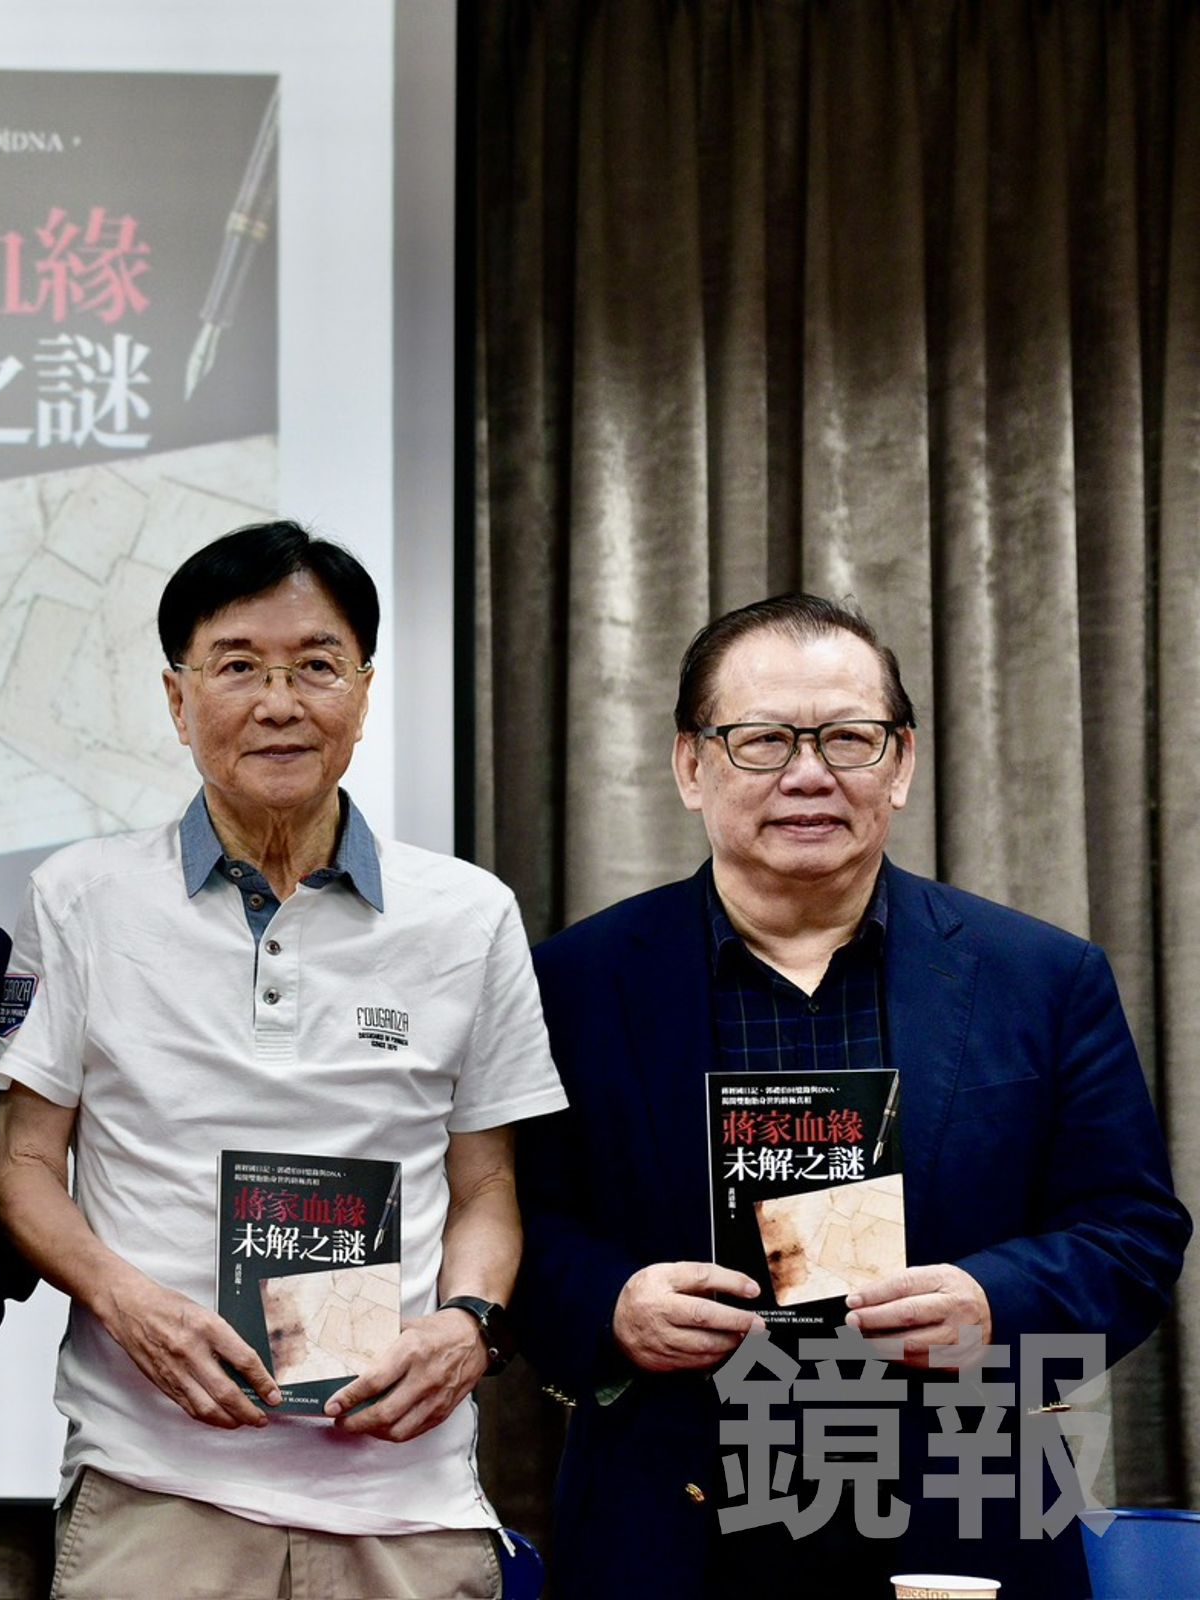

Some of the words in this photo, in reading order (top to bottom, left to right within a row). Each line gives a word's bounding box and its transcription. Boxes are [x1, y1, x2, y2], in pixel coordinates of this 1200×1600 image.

[722, 1108, 863, 1145] 蔣家血緣
[723, 1146, 865, 1181] 未解之謎
[233, 1186, 368, 1228] 蔣家血緣
[231, 1223, 367, 1265] 未解之謎
